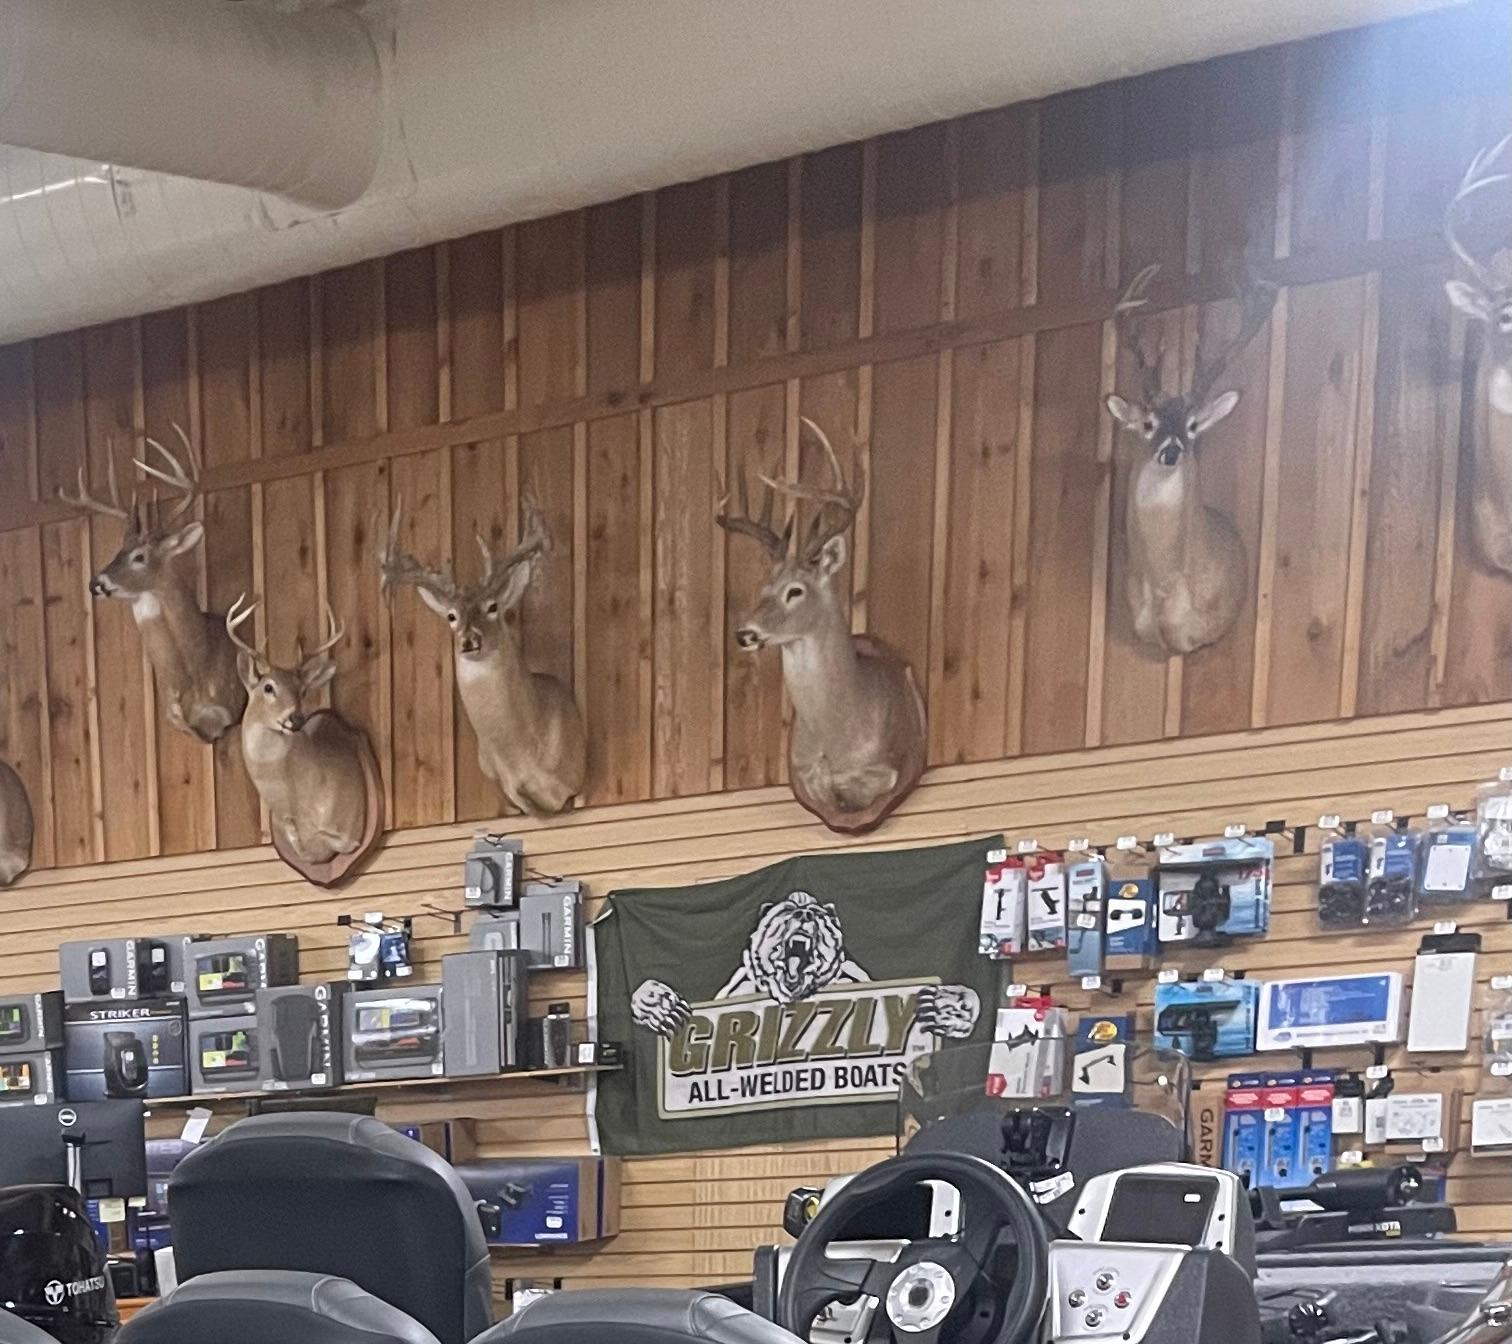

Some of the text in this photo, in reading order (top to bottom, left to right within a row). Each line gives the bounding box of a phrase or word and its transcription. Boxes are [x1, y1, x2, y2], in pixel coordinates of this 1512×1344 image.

[563, 895, 572, 955] GARMIN
[126, 939, 137, 996] GARMIN
[90, 1008, 150, 1020] STRIKER
[671, 995, 919, 1077] GRIZZLY
[688, 1062, 907, 1104] ALL-WELDED BOATS
[66, 1275, 105, 1297] TOHATSU
